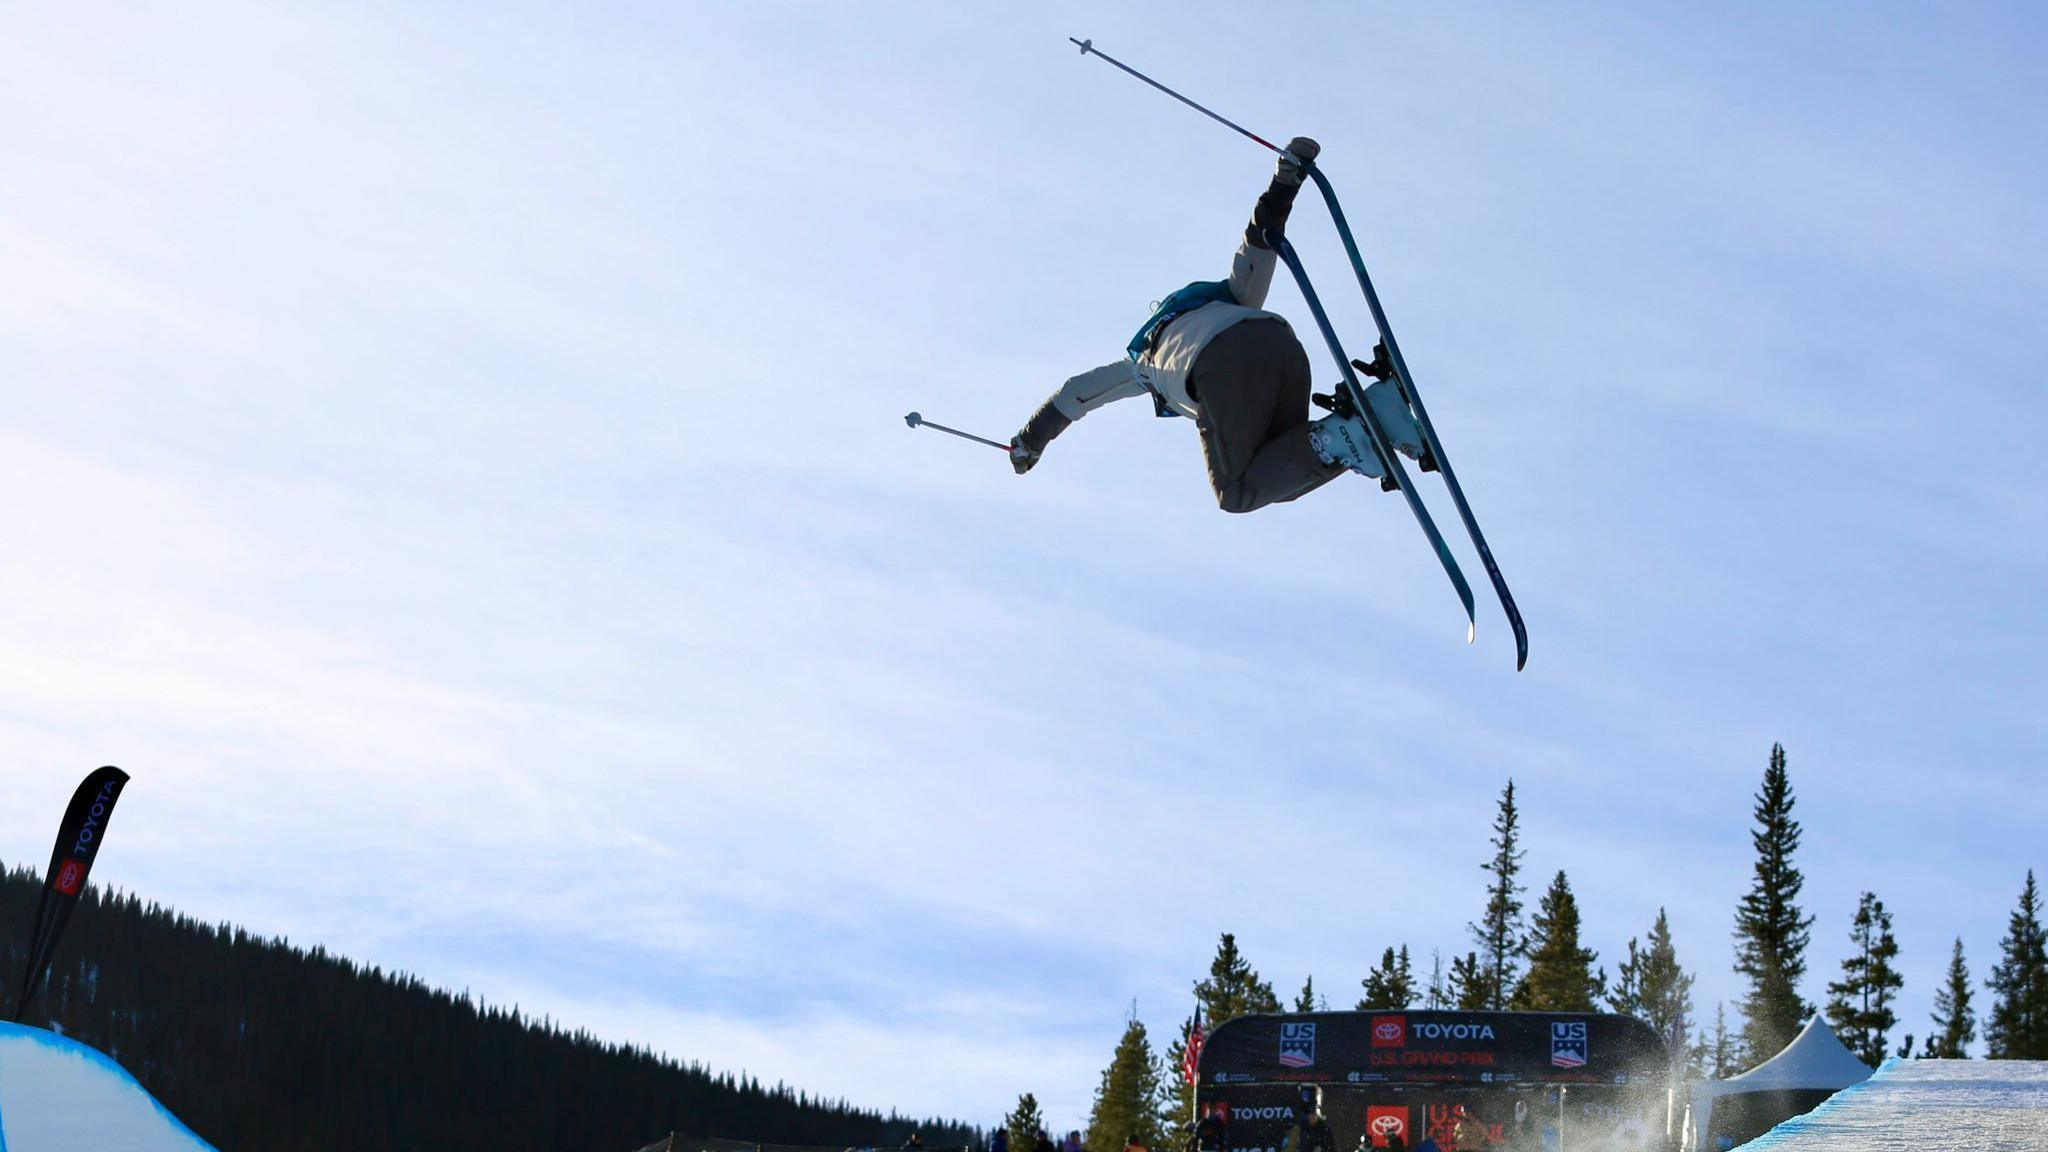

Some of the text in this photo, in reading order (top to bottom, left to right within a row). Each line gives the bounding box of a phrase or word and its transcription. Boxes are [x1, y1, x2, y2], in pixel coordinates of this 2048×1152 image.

[1339, 426, 1363, 463] HEAD
[74, 780, 116, 853] TOYOTA
[1282, 1023, 1314, 1038] US
[1412, 1023, 1496, 1040] TOYOTA
[1552, 1023, 1586, 1038] US
[1402, 1051, 1458, 1066] GRAND
[1460, 1051, 1495, 1066] PRIX
[1231, 1107, 1295, 1120] TOYOTA
